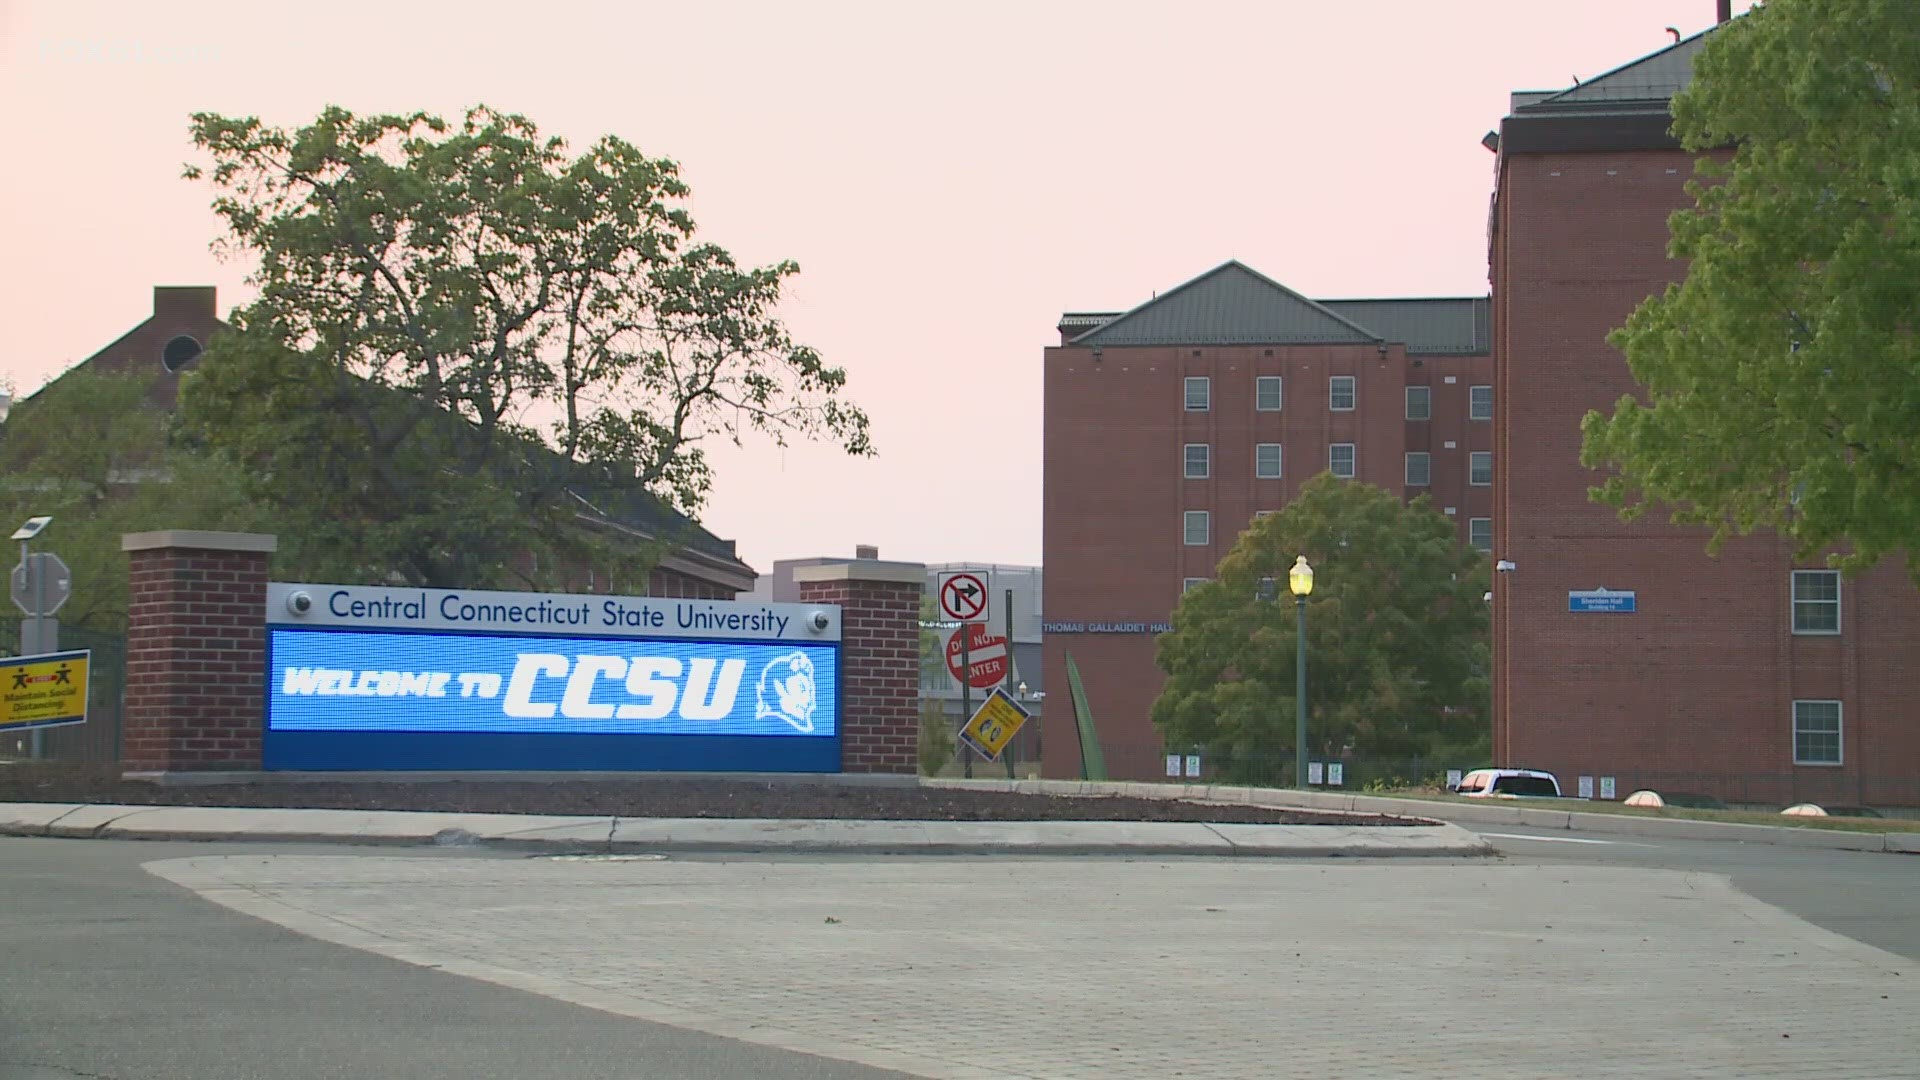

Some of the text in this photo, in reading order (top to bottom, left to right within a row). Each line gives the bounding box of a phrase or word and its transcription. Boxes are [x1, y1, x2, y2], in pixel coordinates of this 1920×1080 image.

[329, 590, 790, 638] Central Connecticut State University
[1043, 623, 1084, 632] THOMAS
[1088, 623, 1145, 632] GALLAUDET
[969, 660, 1000, 679] NTER
[4, 688, 76, 701] Maintain Social
[283, 653, 747, 720] WELCOME TO CCSU
